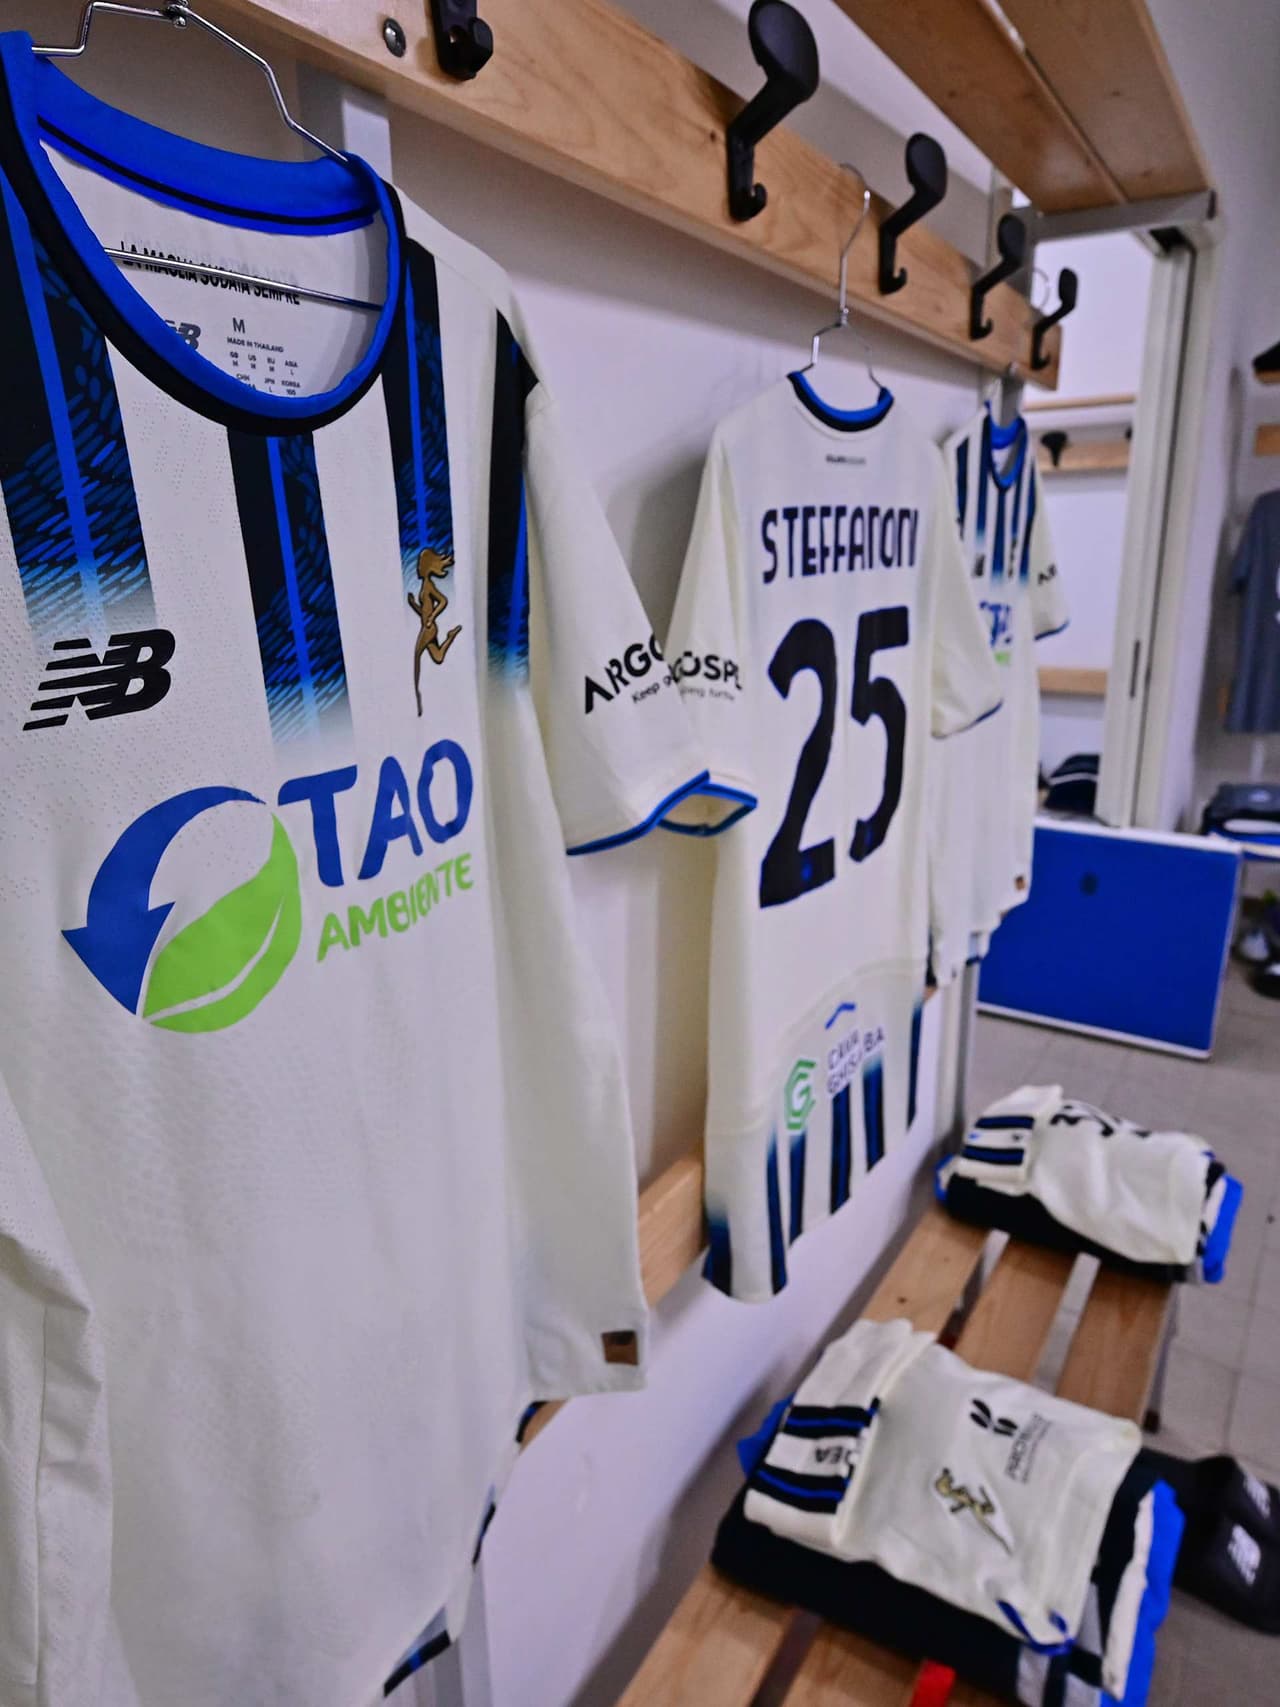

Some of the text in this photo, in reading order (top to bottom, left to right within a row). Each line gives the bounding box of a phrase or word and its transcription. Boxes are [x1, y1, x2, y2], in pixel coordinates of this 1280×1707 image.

[227, 336, 284, 353] MADE IN THAILAND
[232, 317, 246, 334] M
[22, 628, 176, 731] NB
[760, 606, 909, 909] 25
[277, 739, 474, 888] TAO
[316, 852, 475, 963] AMBIENTE
